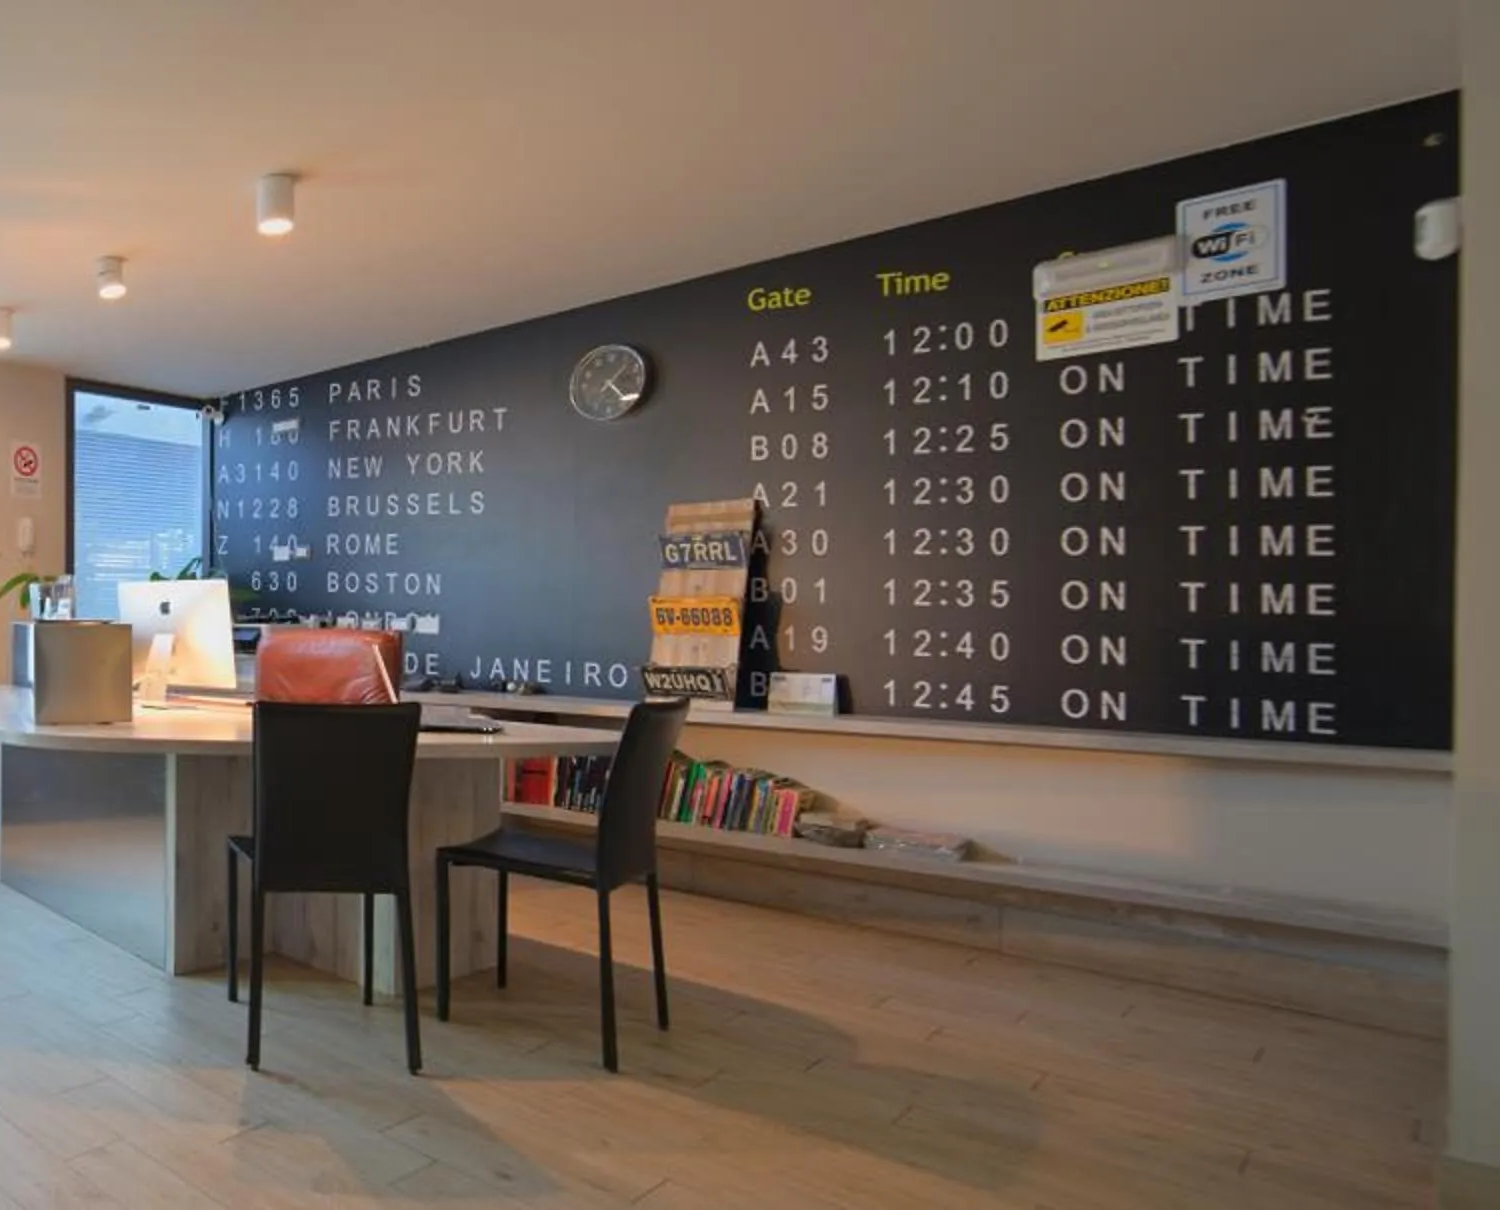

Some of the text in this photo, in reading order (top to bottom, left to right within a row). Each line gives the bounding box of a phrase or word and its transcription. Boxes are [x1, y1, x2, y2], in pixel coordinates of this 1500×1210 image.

[1203, 199, 1256, 220] FREE
[876, 272, 950, 296] Time
[1201, 264, 1258, 284] ZONE
[748, 288, 812, 311] Gate
[1046, 279, 1169, 312] ATTENZIONE!
[750, 335, 829, 368] A43
[884, 319, 1008, 356] 12:00
[1178, 288, 1332, 333] TIME
[329, 375, 420, 403] PARIS
[749, 347, 1333, 415] A15 12:10 ON TIME
[330, 407, 507, 440] FRANKFURT
[751, 406, 1334, 461] B08 12:25 ON TIME
[329, 456, 382, 478] NEW
[407, 450, 483, 475] YORK
[752, 465, 1335, 508] A21 12:30 ON TIME
[328, 491, 484, 516] BRUSSELS
[327, 534, 398, 554] ROME
[664, 541, 738, 563] G7RRL
[750, 524, 1336, 556] A30 12:30 ON TIME
[327, 572, 440, 595] BOSTON
[751, 577, 1336, 616] B01 12:35 ON TIME
[751, 625, 1336, 675] A19 12:40 ON TIME
[405, 652, 628, 688] DE JANEIRO
[884, 679, 1336, 734] 12:45 ON TIME
